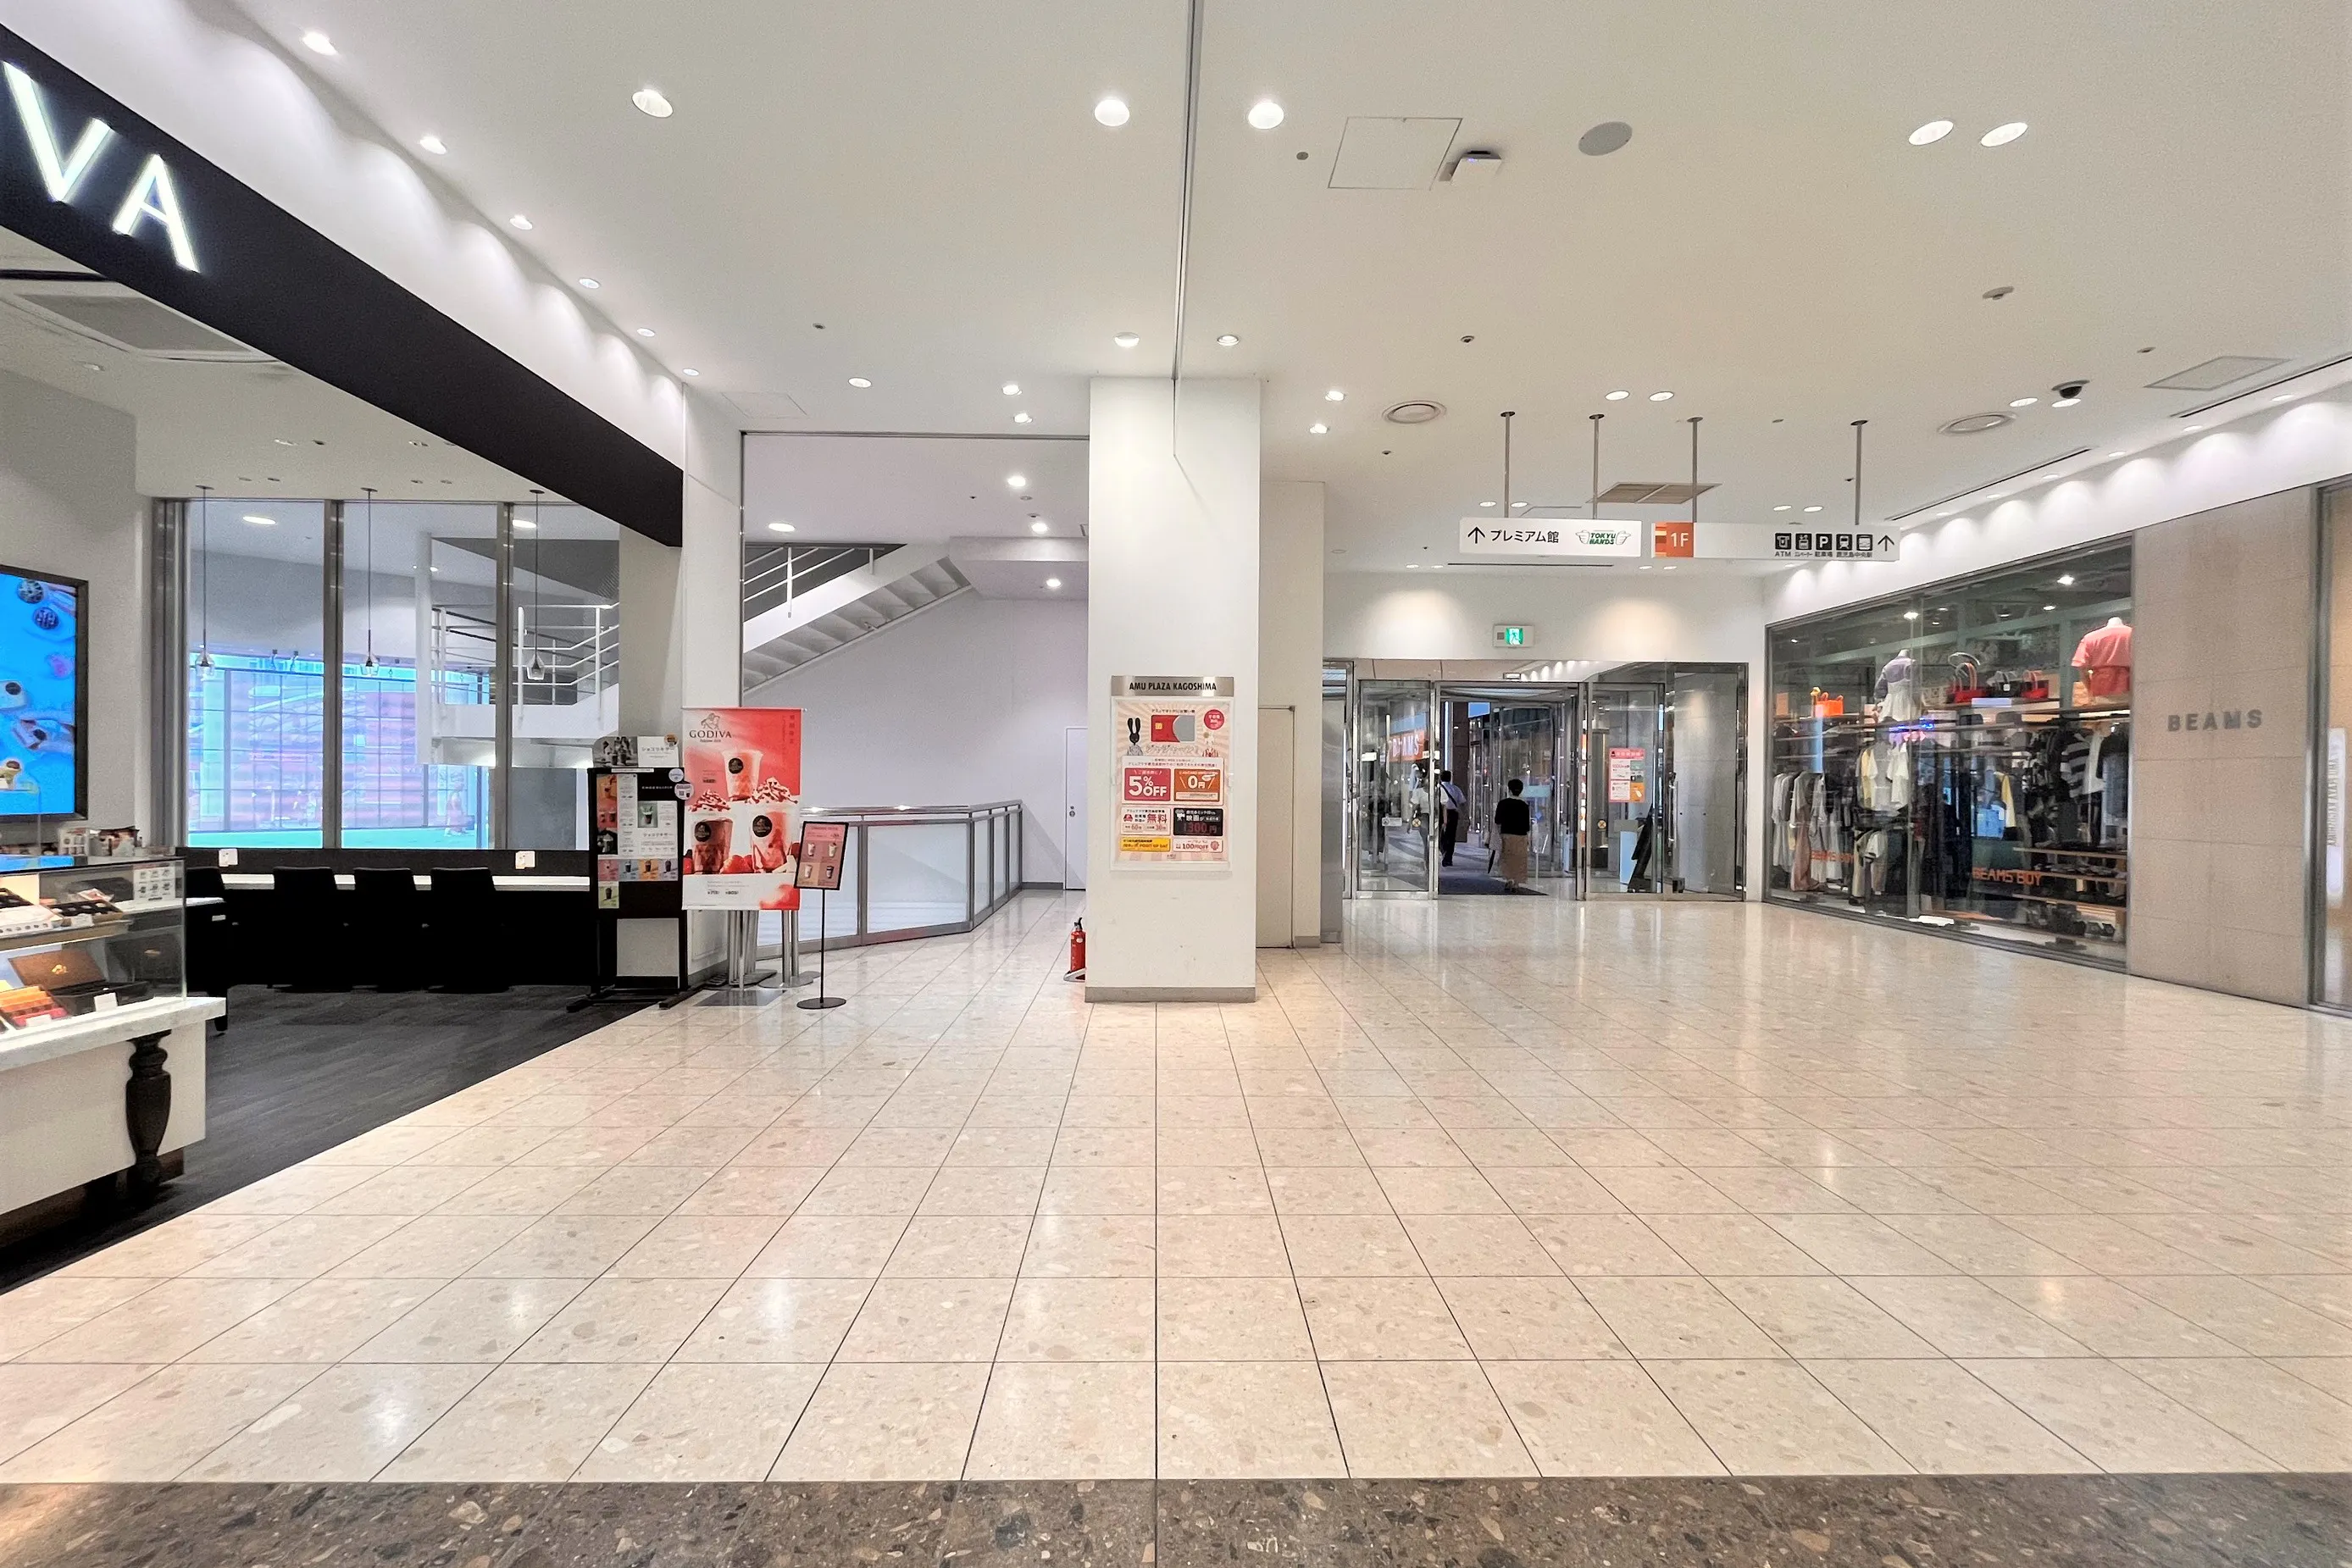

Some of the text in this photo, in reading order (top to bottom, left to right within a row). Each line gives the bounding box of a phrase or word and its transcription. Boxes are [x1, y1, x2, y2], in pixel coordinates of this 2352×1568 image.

[3, 60, 201, 274] VA
[1490, 529, 1559, 544] プレミアム館
[1670, 532, 1689, 547] 1F
[1129, 682, 1217, 690] AMU PLAZA KAGOSHIMA
[2167, 709, 2262, 731] BEAMS
[689, 730, 733, 739] GODIVA
[1187, 775, 1206, 790] 0円
[1143, 786, 1168, 796] OFF
[1147, 813, 1168, 823] 無料
[1972, 868, 2041, 886] BEAMS BOY
